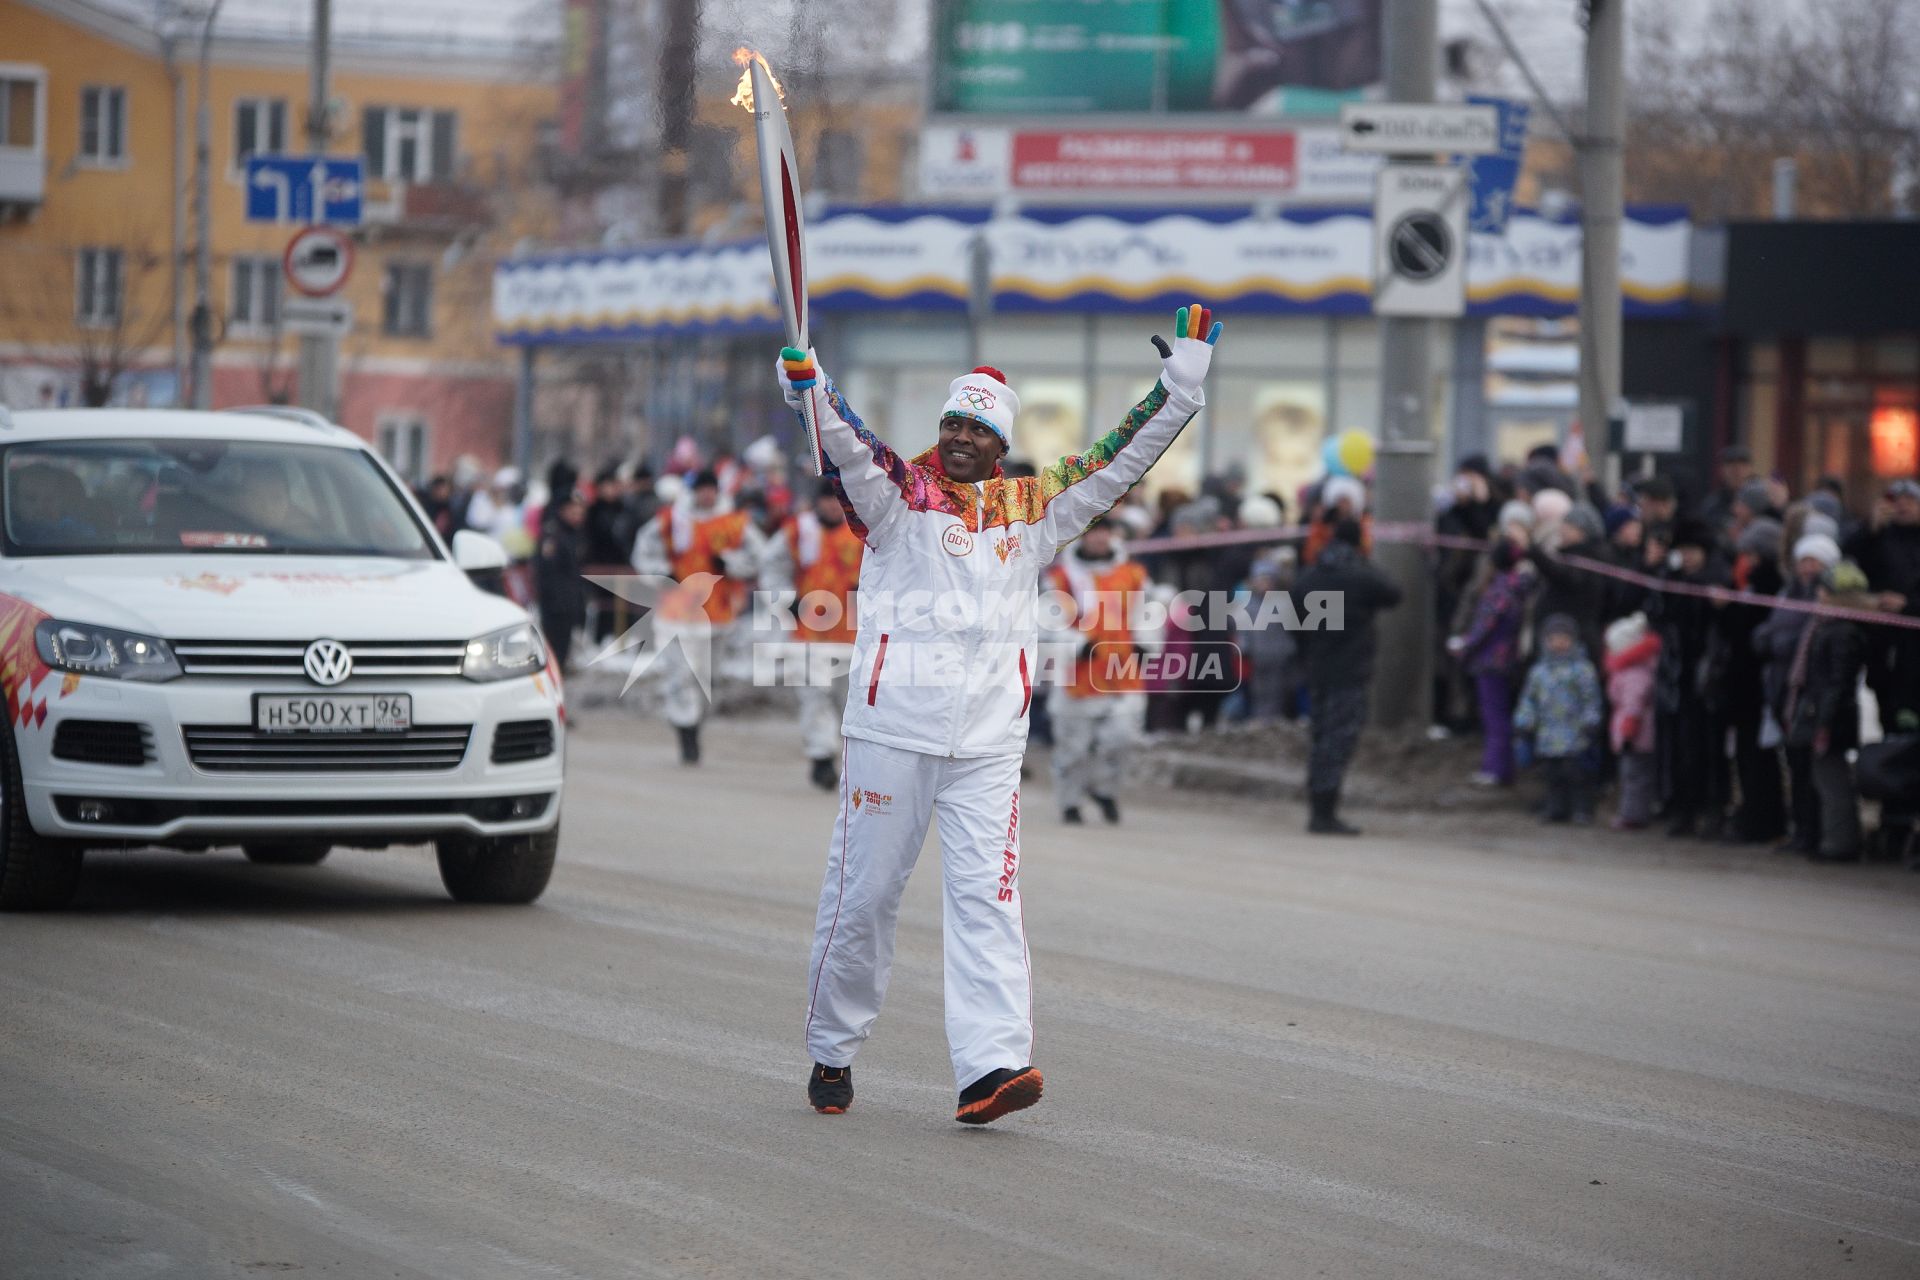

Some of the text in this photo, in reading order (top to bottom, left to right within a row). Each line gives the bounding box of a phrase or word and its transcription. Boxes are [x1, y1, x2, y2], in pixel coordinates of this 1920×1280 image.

[947, 533, 969, 549] 004
[377, 699, 401, 719] 96
[997, 791, 1019, 903] SOCHI 2014
